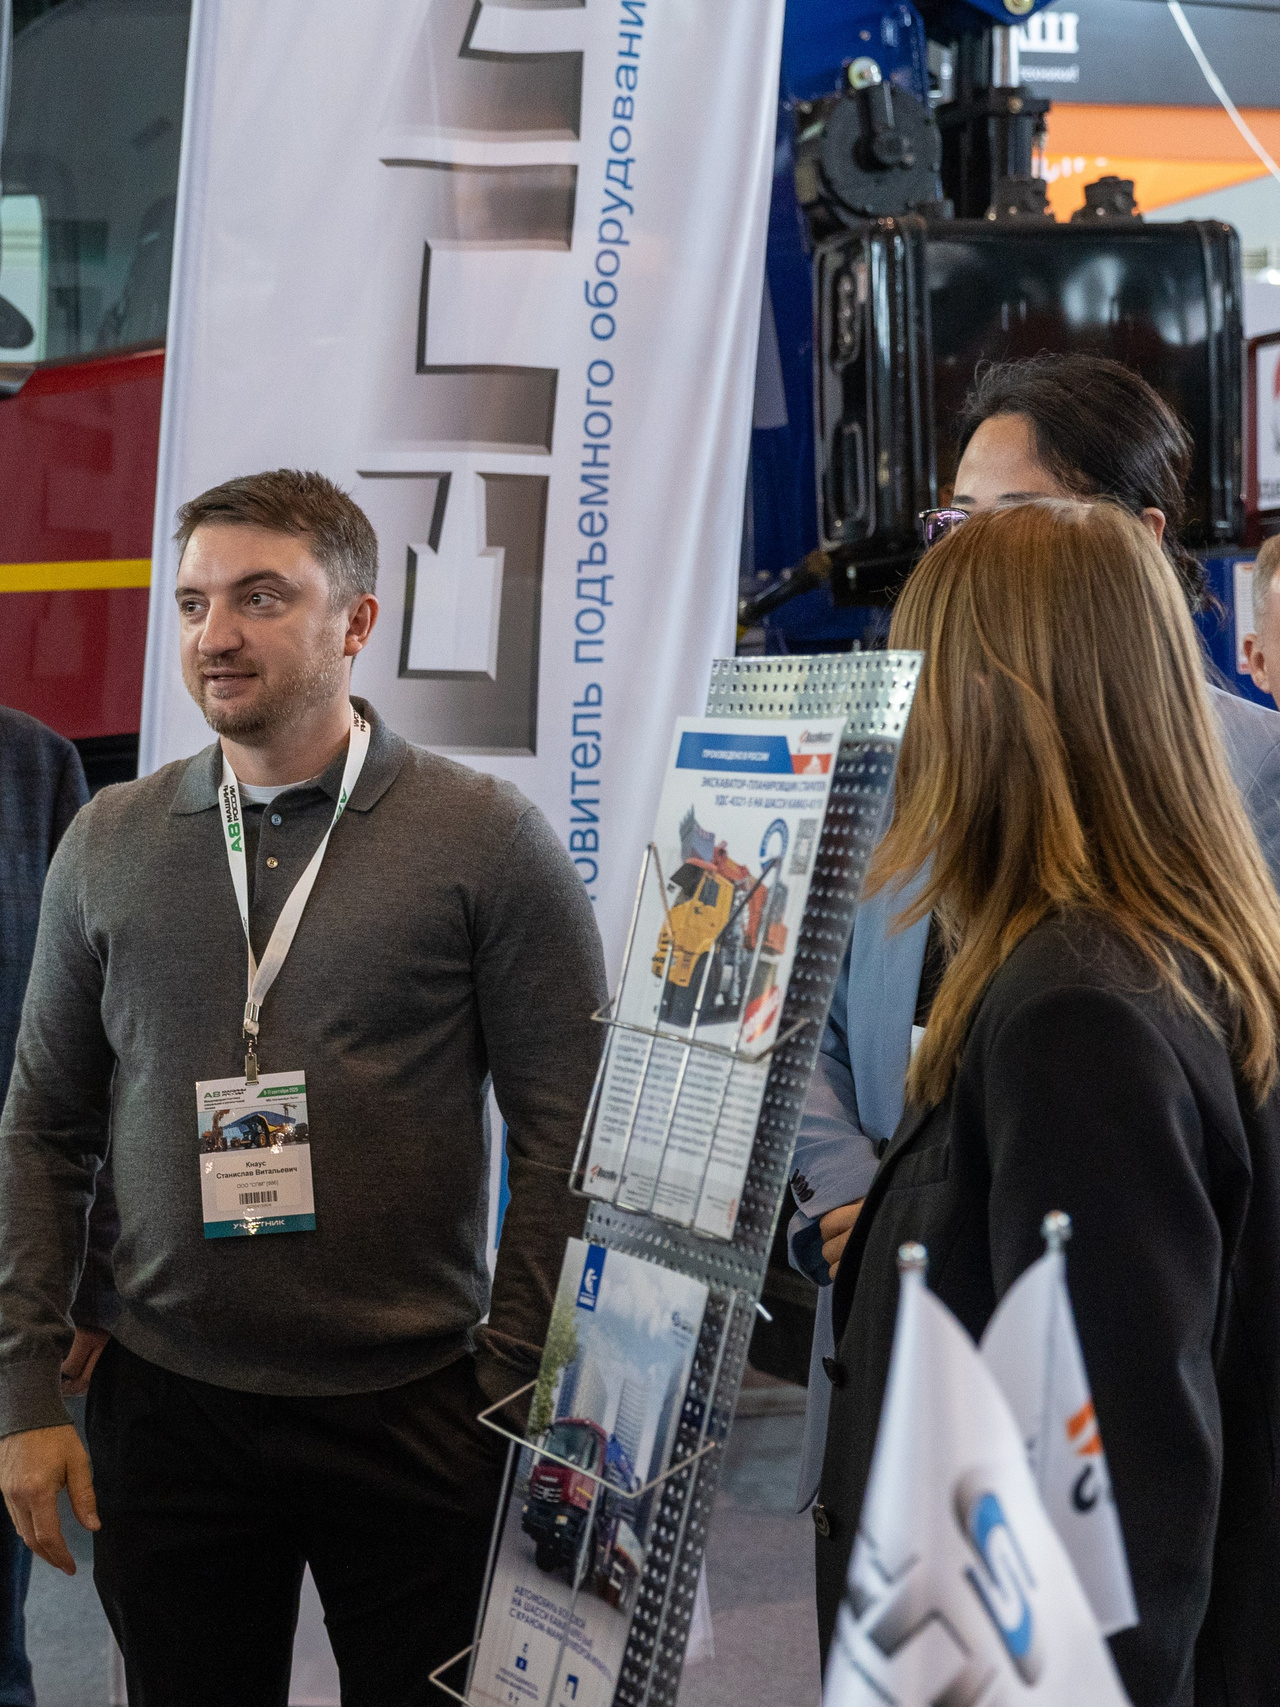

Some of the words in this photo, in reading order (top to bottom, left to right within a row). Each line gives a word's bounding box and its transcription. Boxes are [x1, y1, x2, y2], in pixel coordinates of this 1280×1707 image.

[574, 359, 614, 664] подъемного
[230, 784, 240, 821] РОССИИ
[568, 682, 604, 902] овитель
[245, 1161, 267, 1169] Кнаус
[255, 1166, 298, 1176] Витальевич
